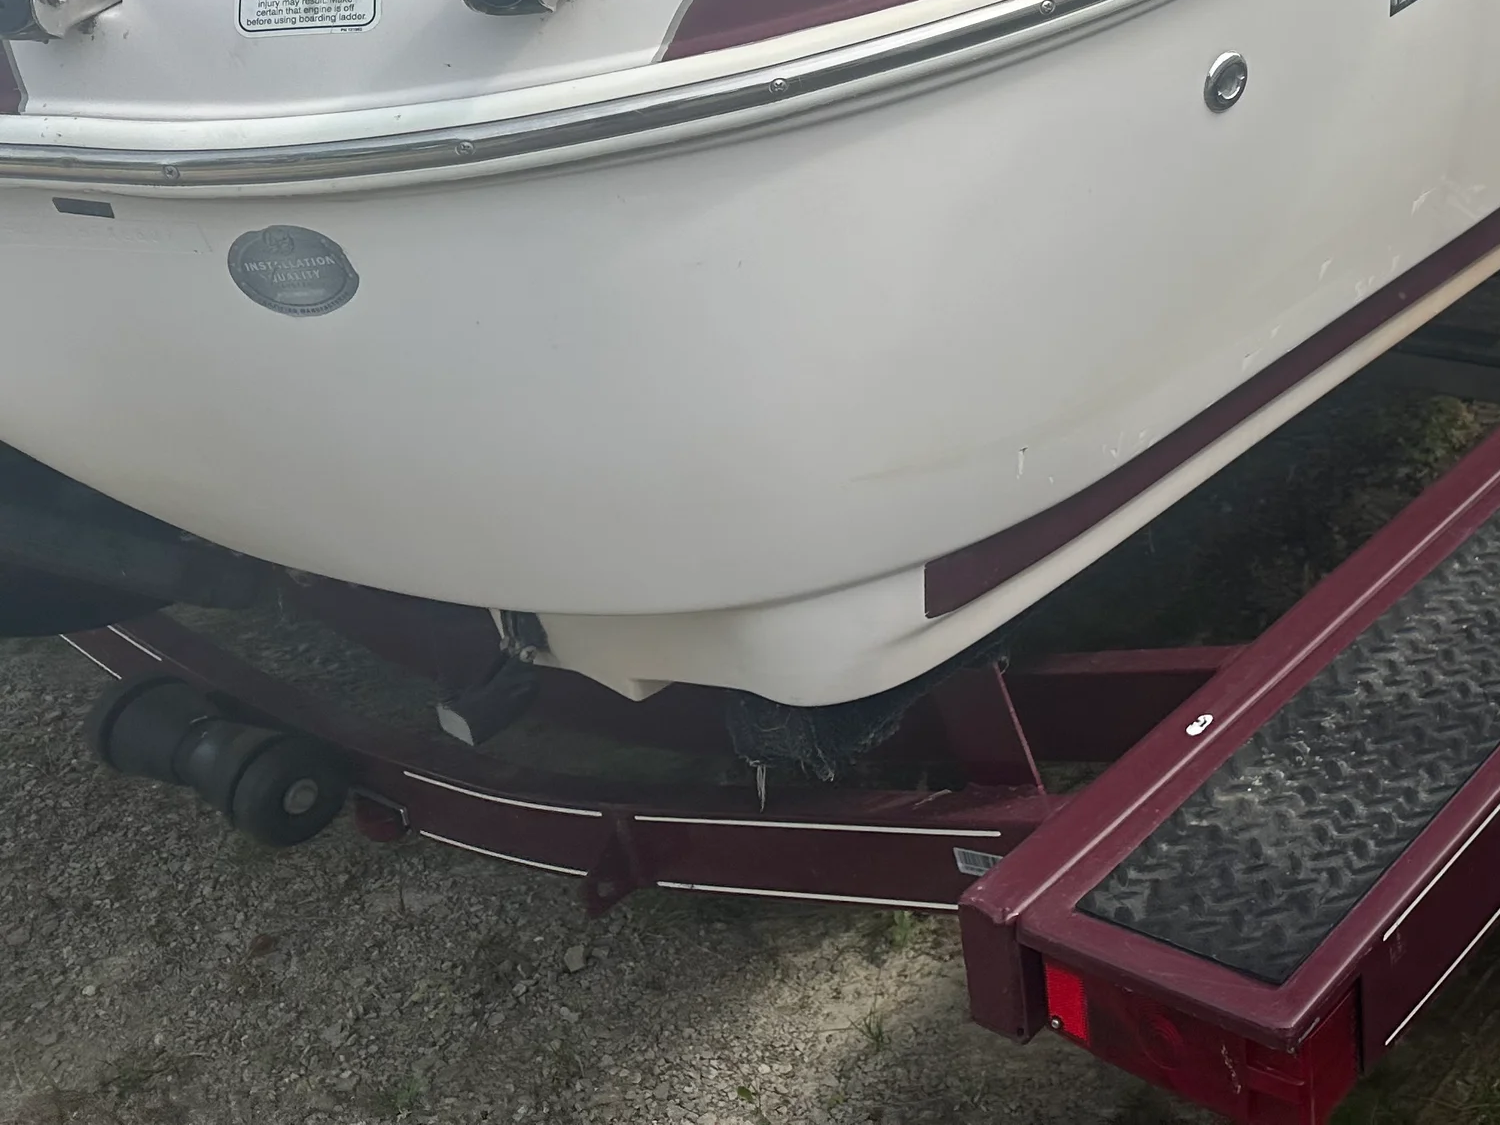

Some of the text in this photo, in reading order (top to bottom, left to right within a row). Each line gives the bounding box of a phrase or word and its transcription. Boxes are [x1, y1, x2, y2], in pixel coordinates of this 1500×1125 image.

[256, 4, 355, 16] certain that engine is off
[258, 0, 280, 9] injury
[282, 0, 299, 7] may
[246, 12, 367, 26] before using boarding ladder.
